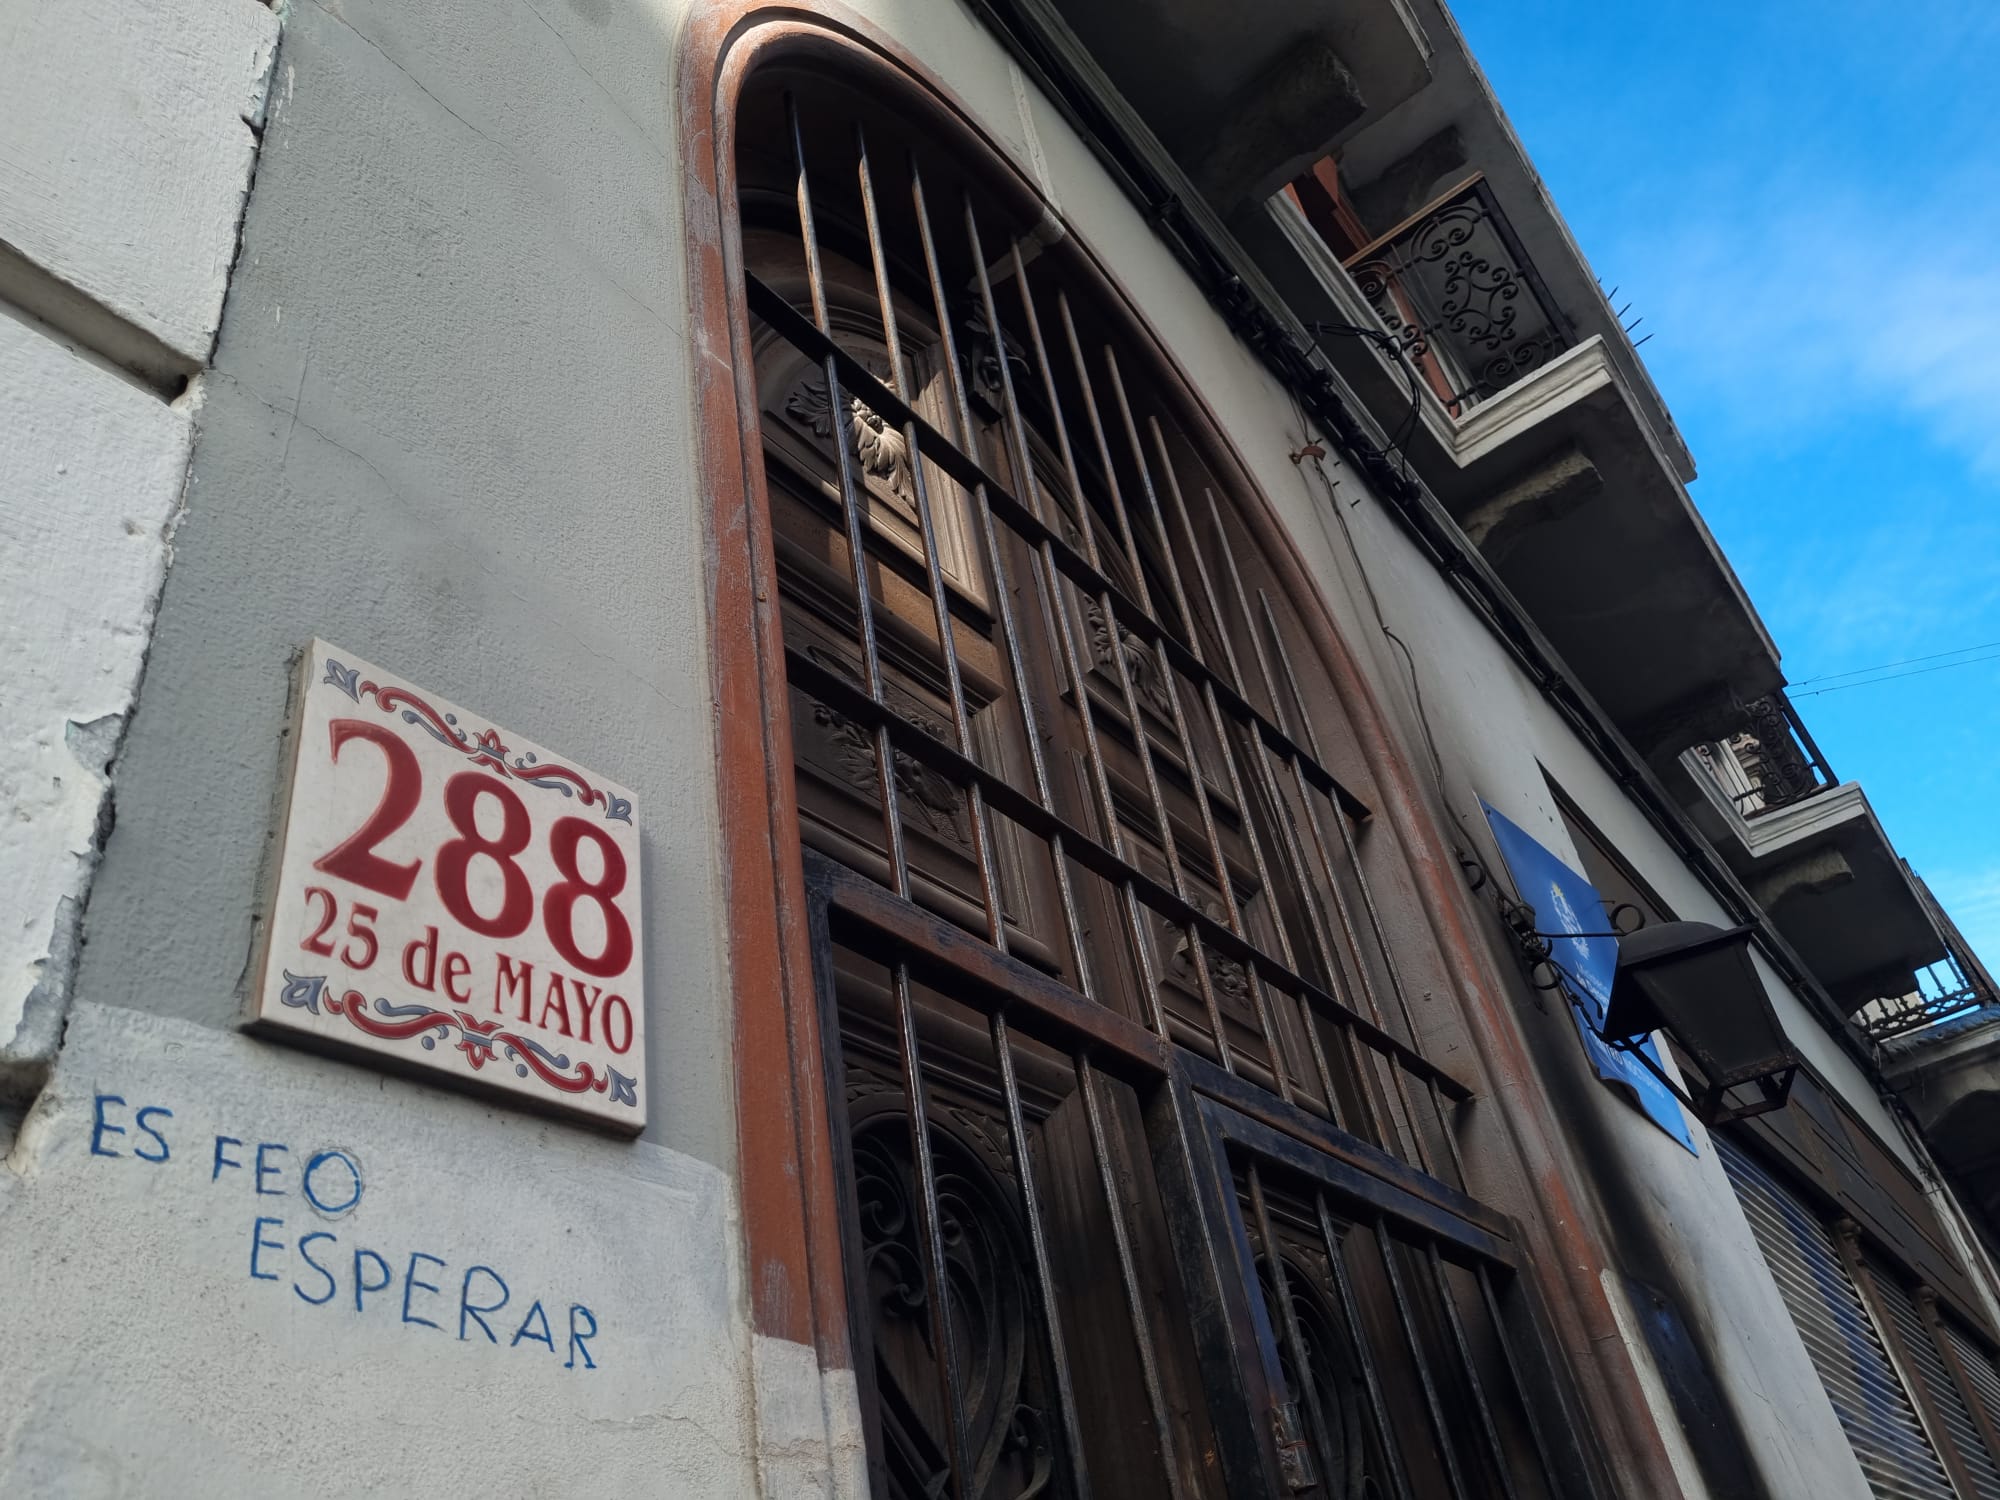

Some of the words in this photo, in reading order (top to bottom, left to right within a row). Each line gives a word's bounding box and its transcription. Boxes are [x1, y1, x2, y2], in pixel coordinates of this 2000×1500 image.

[313, 718, 633, 978] 288
[300, 886, 379, 971] 25
[402, 925, 472, 1005] de
[493, 951, 634, 1055] MAYO
[90, 1093, 174, 1163] ES
[212, 1136, 362, 1214] FEO
[249, 1216, 598, 1369] ESPERAR
